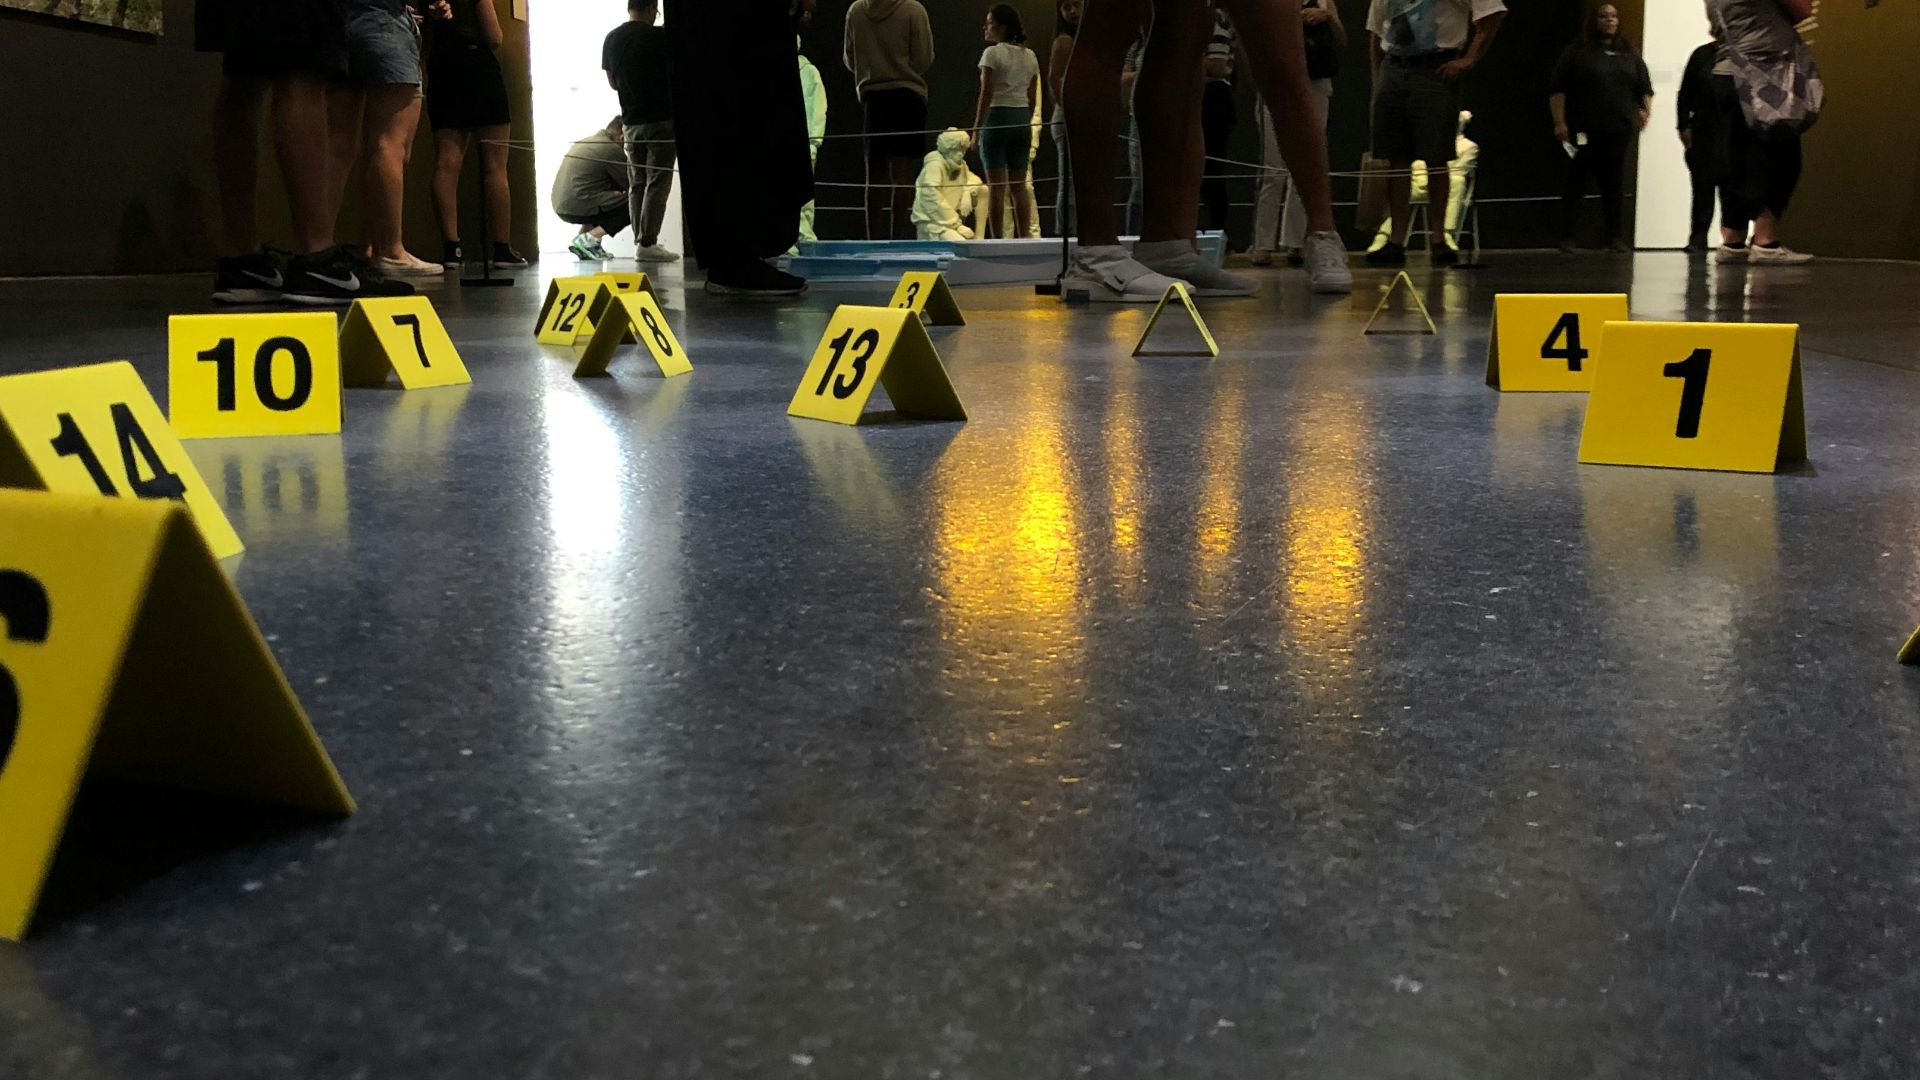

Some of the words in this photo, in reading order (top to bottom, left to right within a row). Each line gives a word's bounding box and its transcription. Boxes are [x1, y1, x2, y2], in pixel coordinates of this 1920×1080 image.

[392, 314, 431, 368] 7
[552, 293, 586, 332] 12
[640, 307, 673, 357] 8
[1541, 312, 1589, 372] 4
[197, 336, 313, 412] 10
[815, 327, 880, 400] 13
[1663, 348, 1713, 439] 1
[50, 402, 187, 500] 14
